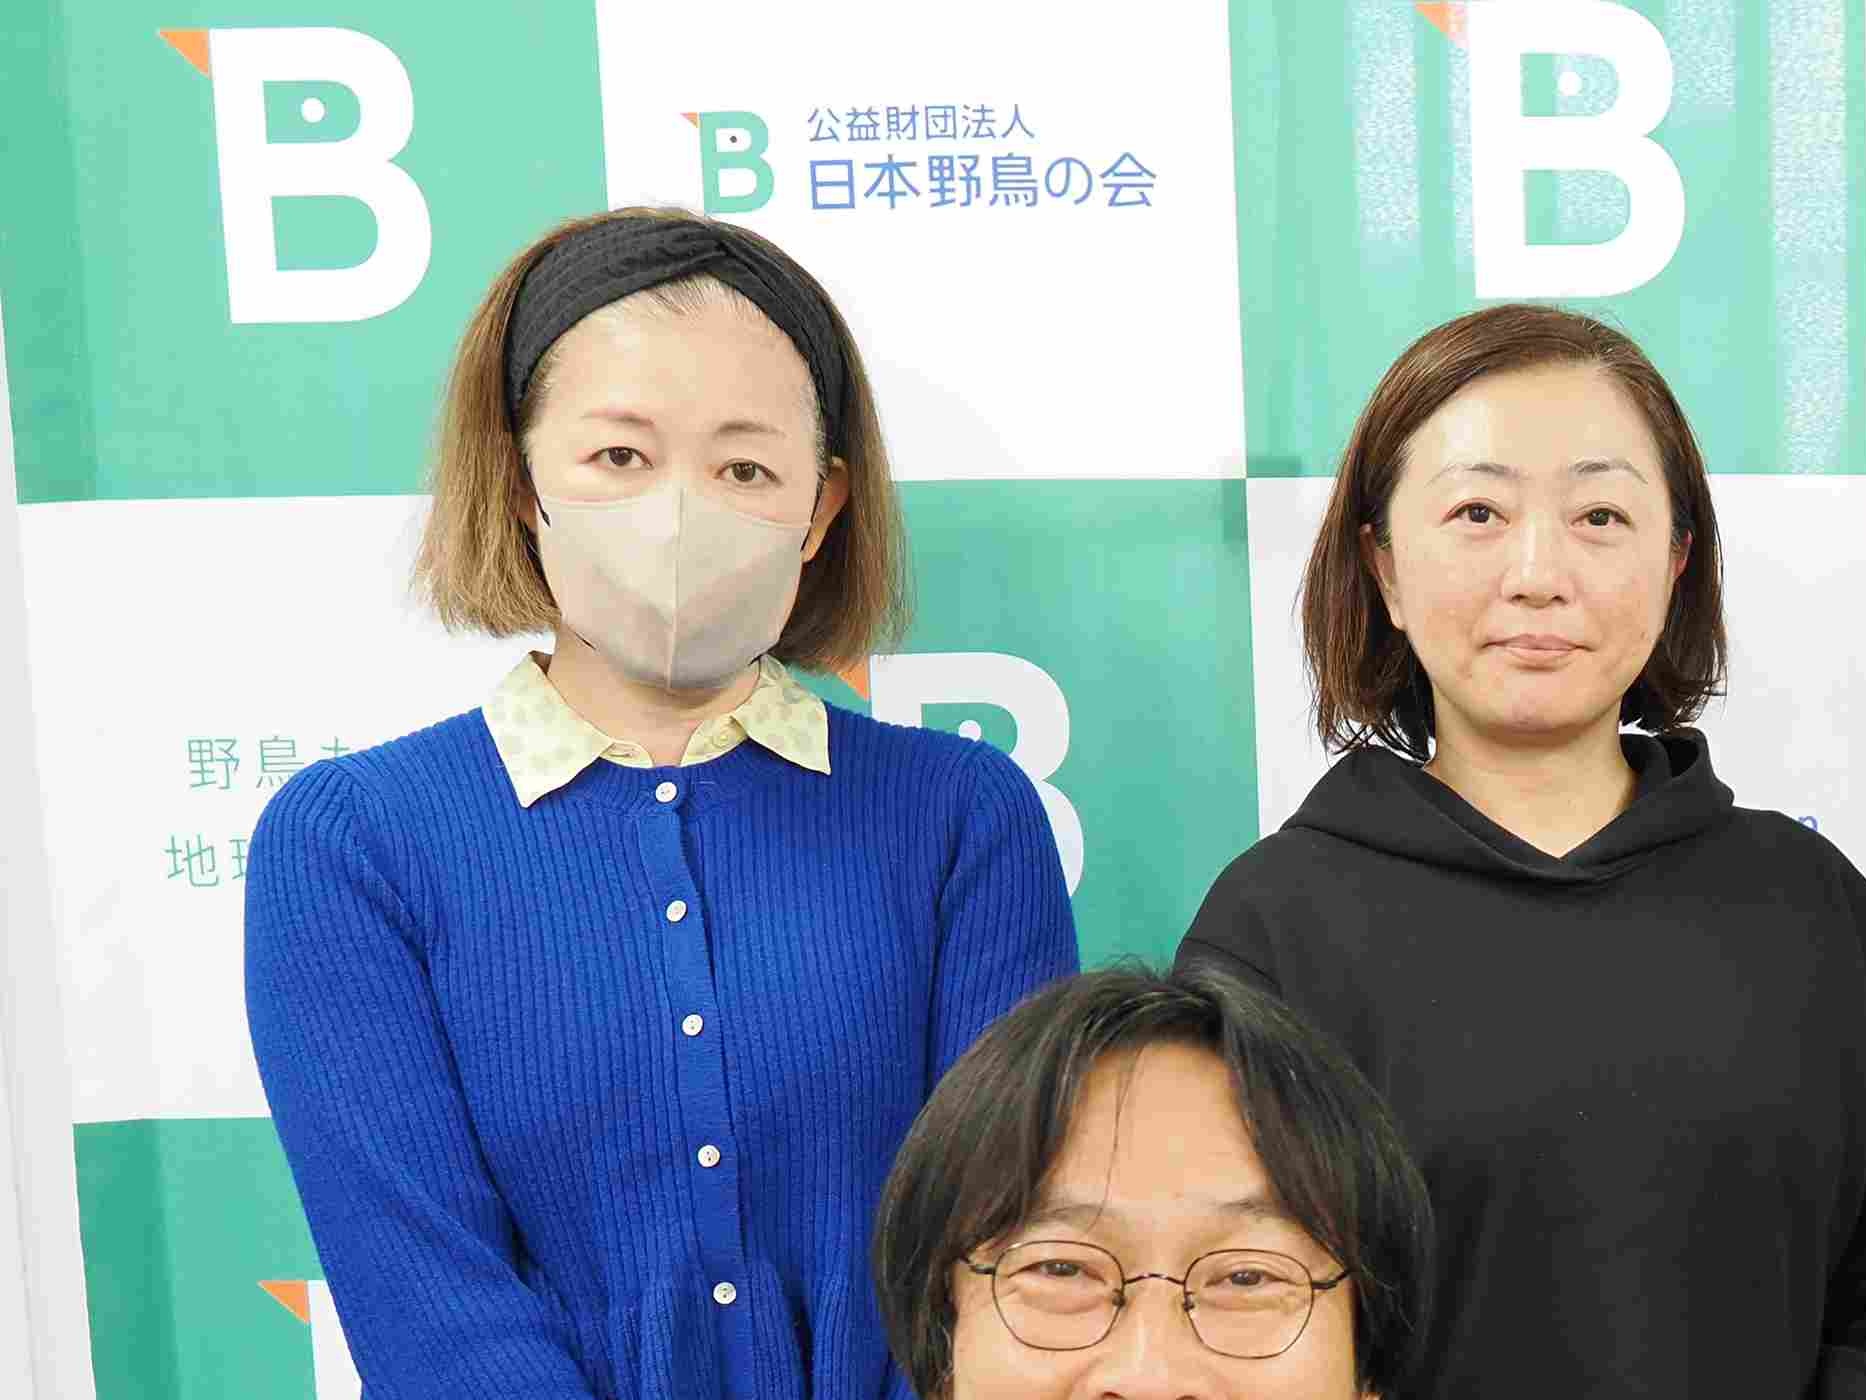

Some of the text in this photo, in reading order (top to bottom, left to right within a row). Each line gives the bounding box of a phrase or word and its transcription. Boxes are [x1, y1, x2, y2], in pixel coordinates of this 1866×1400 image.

[698, 110, 775, 217] B
[807, 103, 1036, 143] 公益財団法人
[1464, 0, 1686, 299] B
[208, 26, 433, 325] B
[808, 151, 1158, 210] 日本野鳥の会
[187, 735, 351, 790] 野鳥
